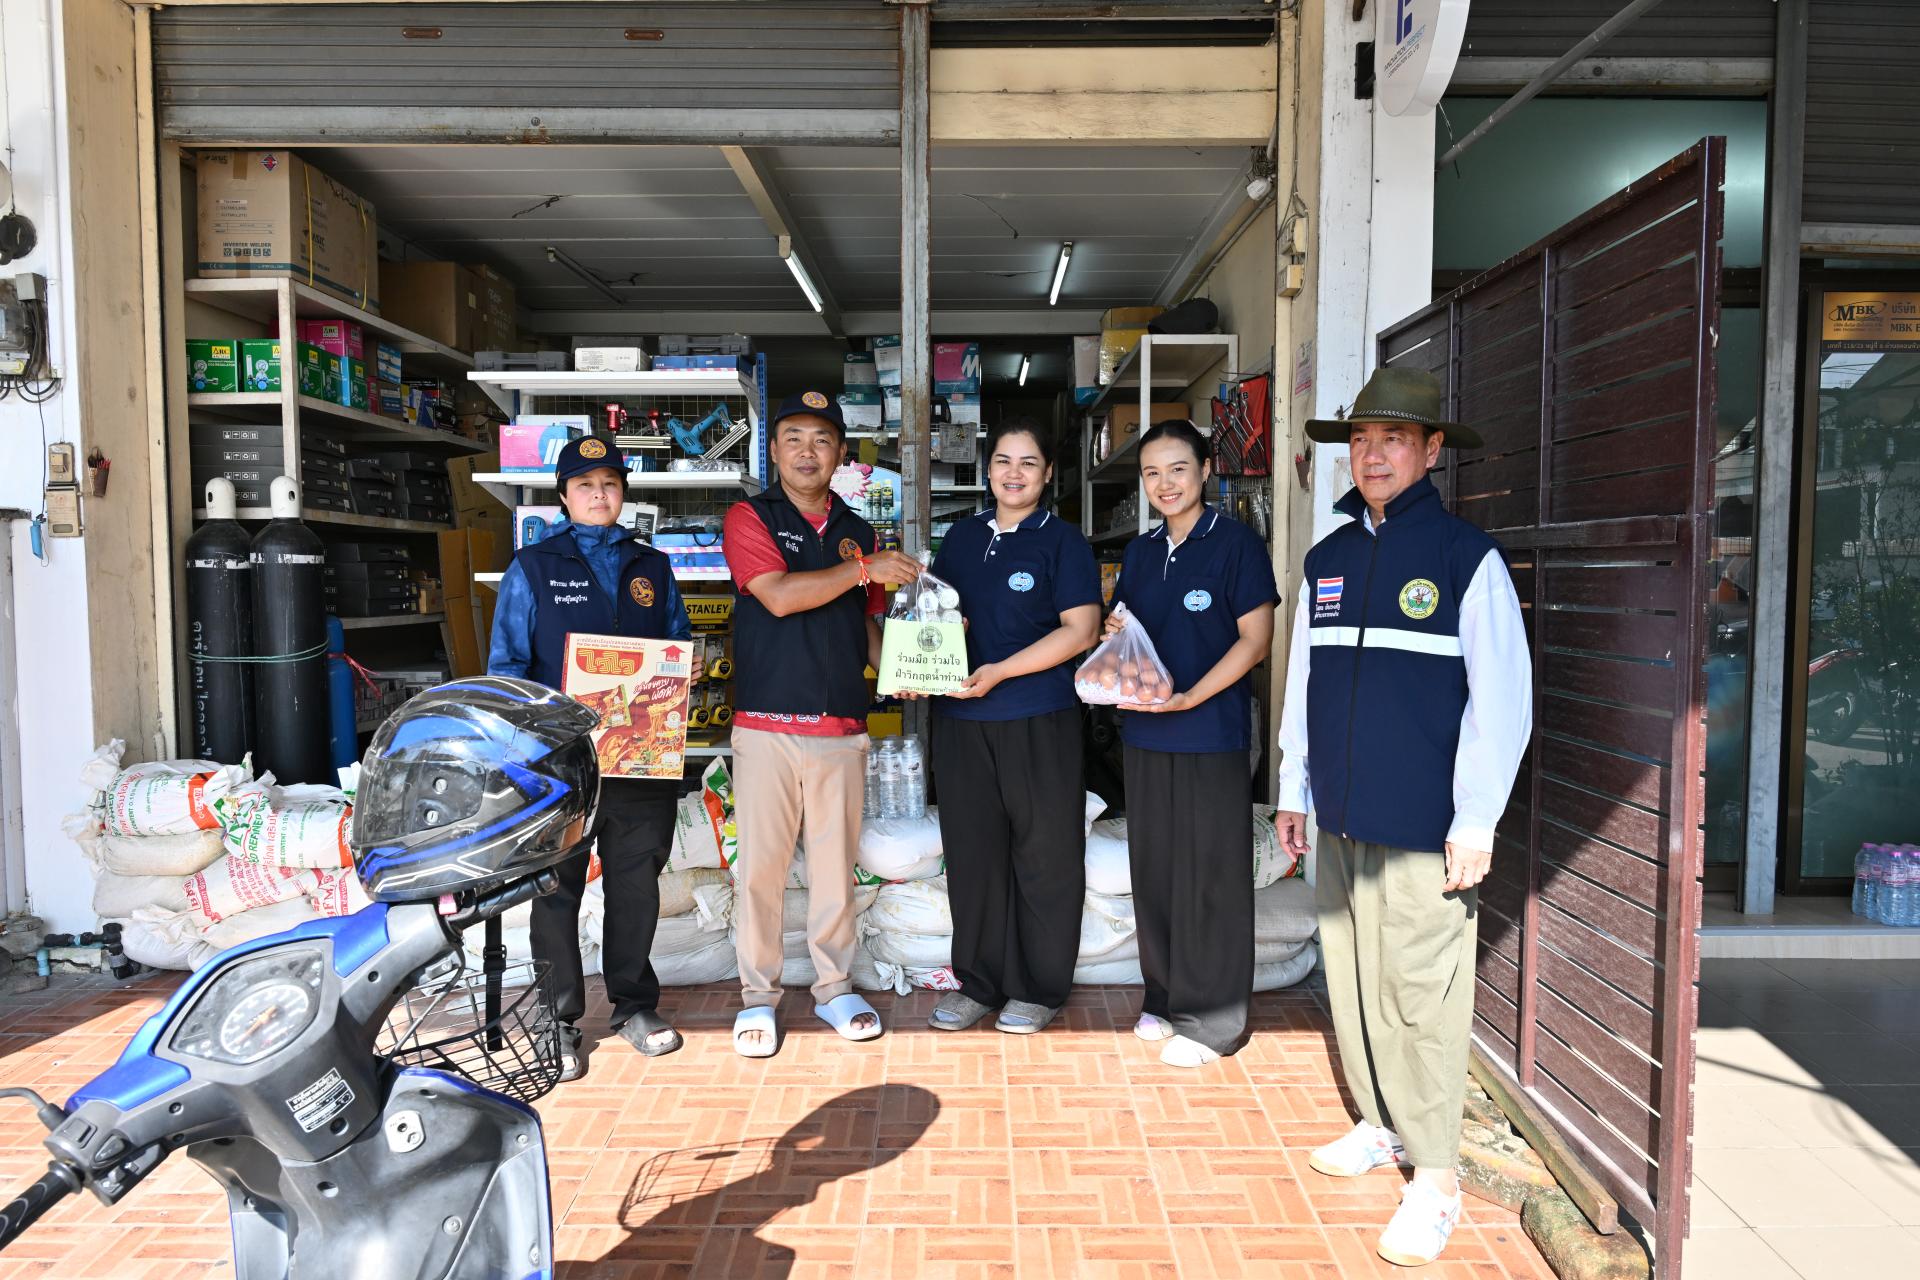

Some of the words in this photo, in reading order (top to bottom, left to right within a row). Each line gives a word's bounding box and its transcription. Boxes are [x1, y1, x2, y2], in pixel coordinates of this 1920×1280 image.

[1836, 304, 1875, 321] MBK
[1892, 302, 1916, 314] บริษัท
[1890, 324, 1912, 332] MBK
[686, 604, 729, 614] STANLEY
[577, 650, 634, 674] ไวไว
[897, 652, 928, 664] ร่วมมือ
[932, 654, 961, 666] ร่วมใจ
[250, 814, 263, 851] REFINED
